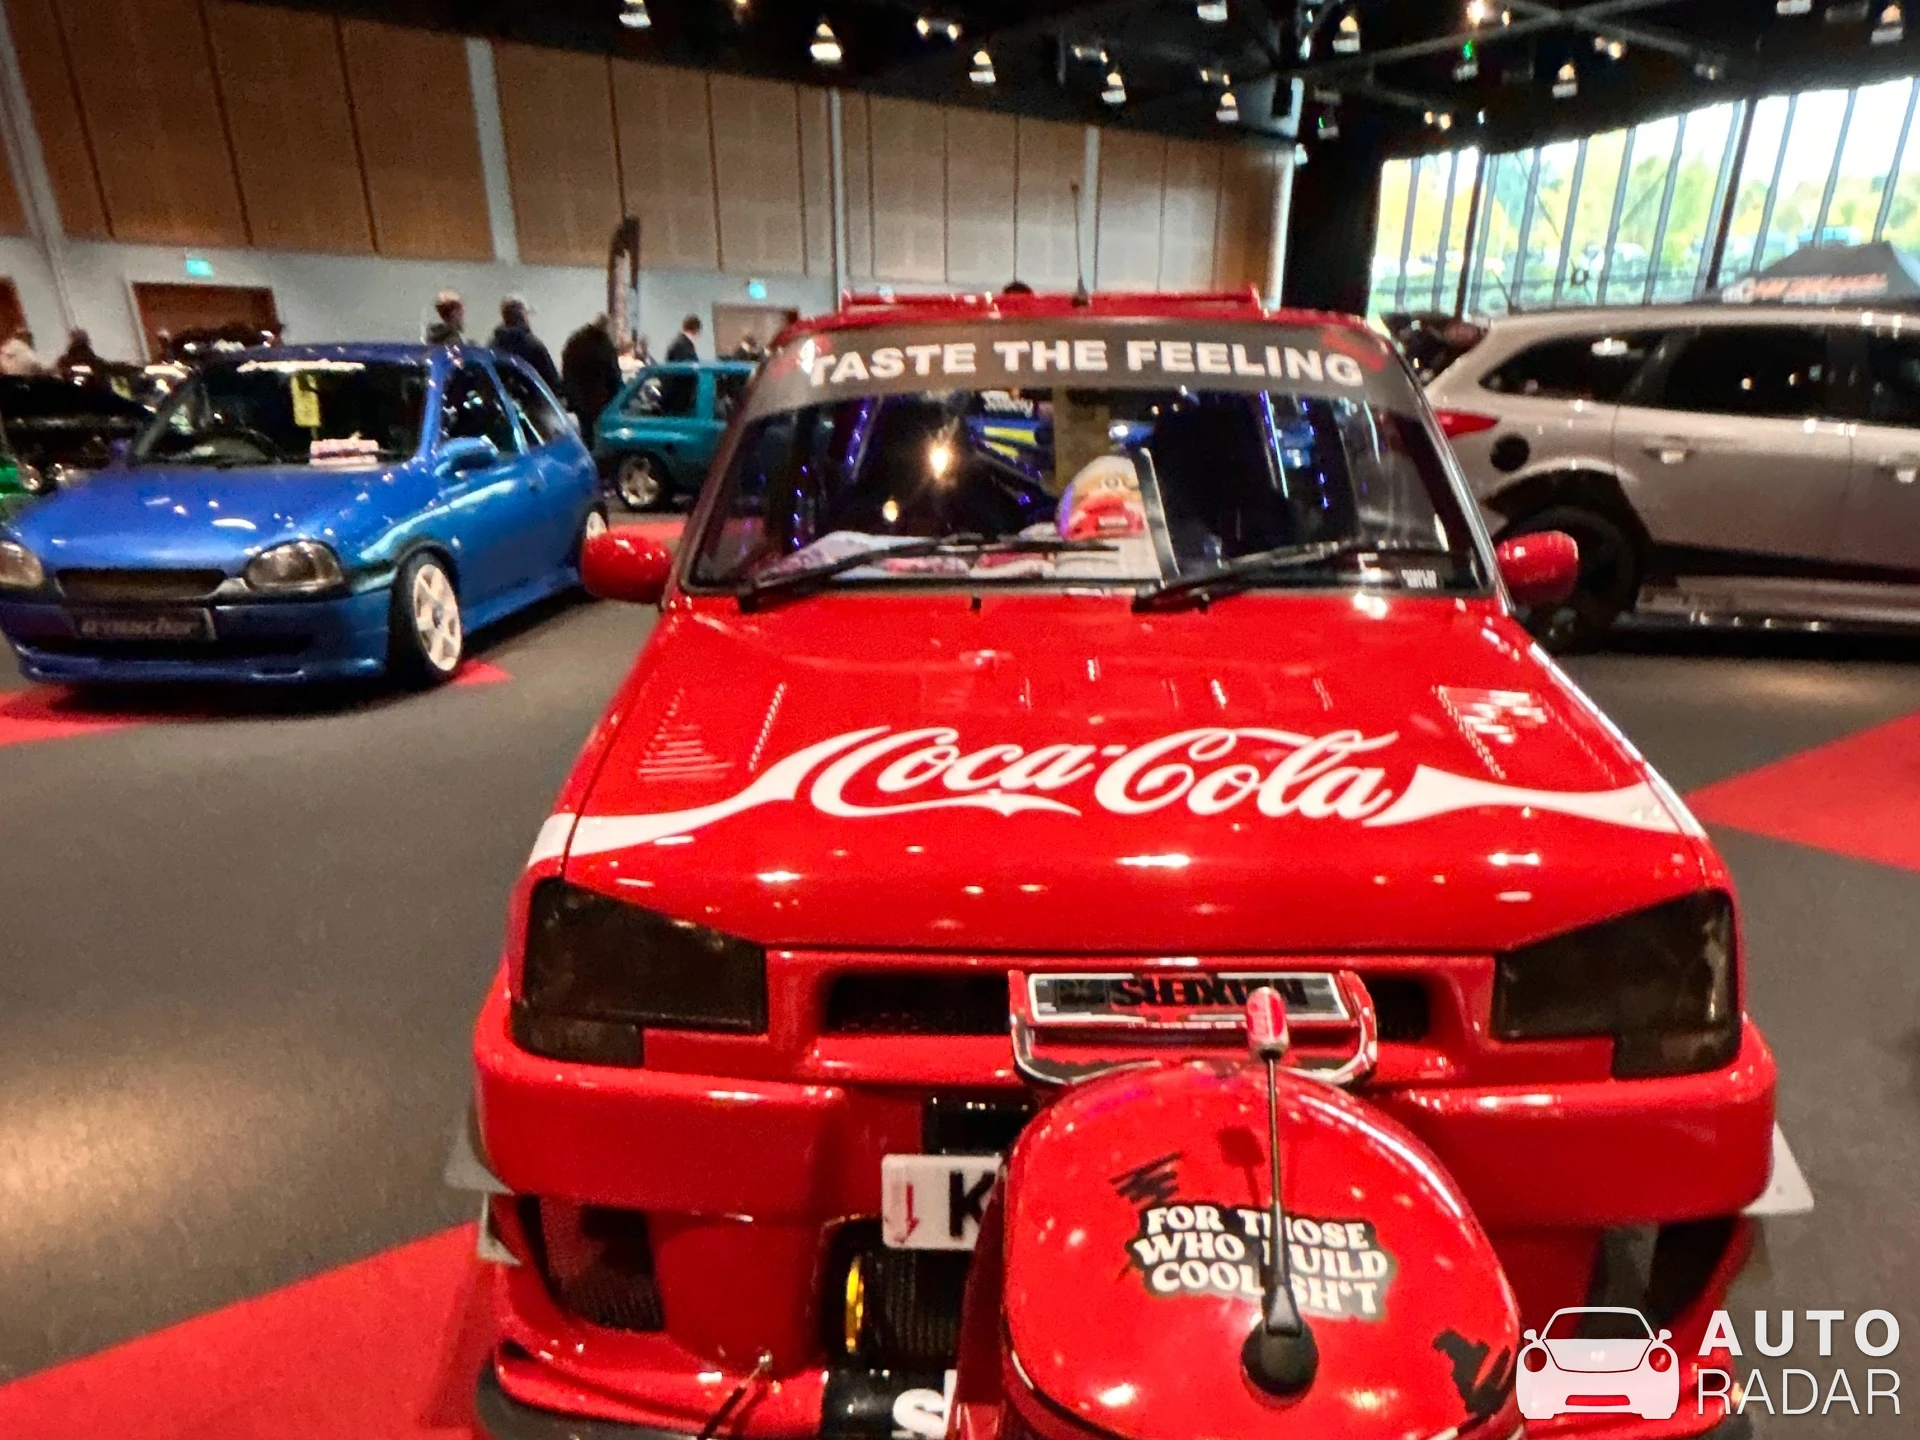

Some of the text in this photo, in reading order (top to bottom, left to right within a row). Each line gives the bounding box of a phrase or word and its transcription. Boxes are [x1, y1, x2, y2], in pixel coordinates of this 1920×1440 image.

[809, 340, 1363, 387] TASTE THE FEELING
[810, 725, 1398, 818] Coca-Cola
[1147, 1205, 1225, 1235] FOR
[1133, 1231, 1388, 1280] WHO UILD
[1151, 1260, 1266, 1296] COOL
